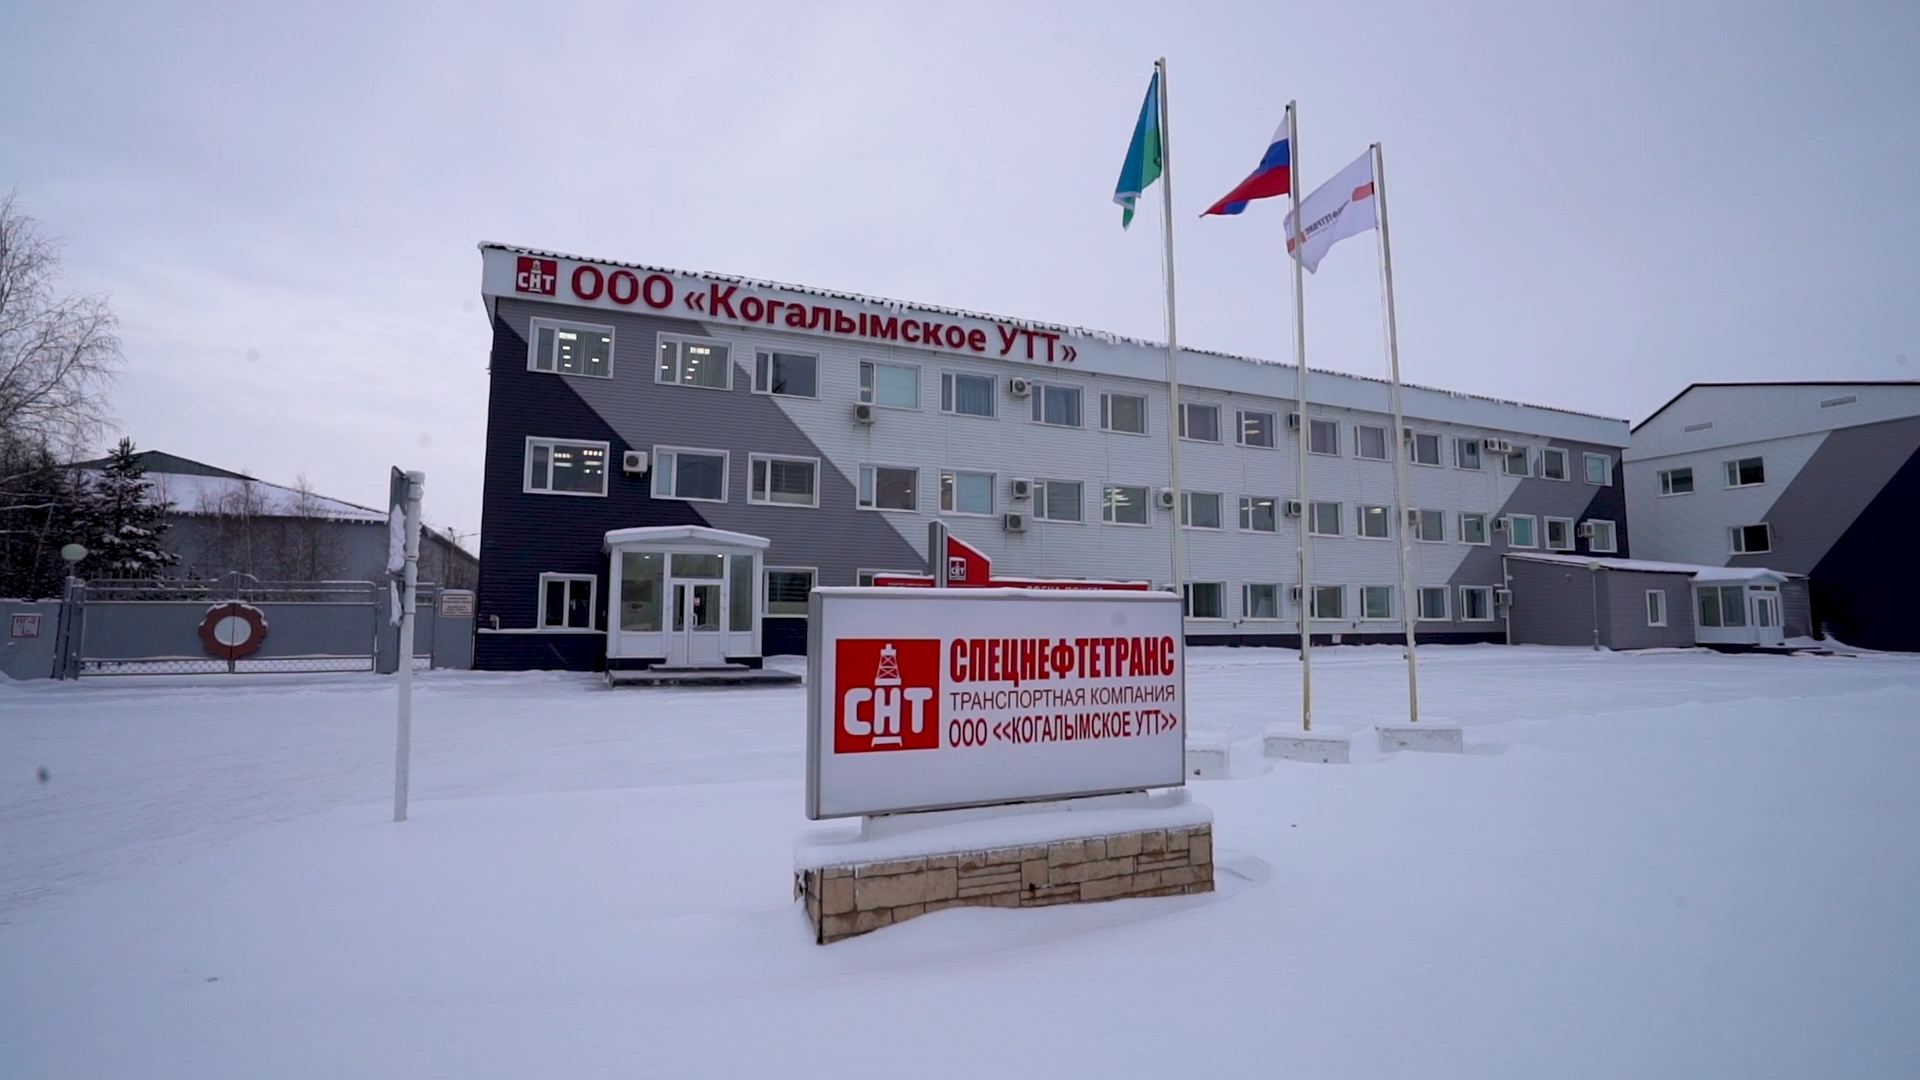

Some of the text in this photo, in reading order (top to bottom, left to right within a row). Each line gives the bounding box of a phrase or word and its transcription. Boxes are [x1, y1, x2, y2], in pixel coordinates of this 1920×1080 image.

[517, 269, 555, 293] СНТ
[571, 265, 1078, 363] ООО «Когалымское УТТ»
[950, 636, 1174, 688] СПЕЦНЕФТЕТРАНС
[843, 686, 933, 736] СНТ
[950, 685, 1175, 711] ТРАНСПОРТНАЯ КОМПАНИЯ
[949, 718, 987, 748] ООО
